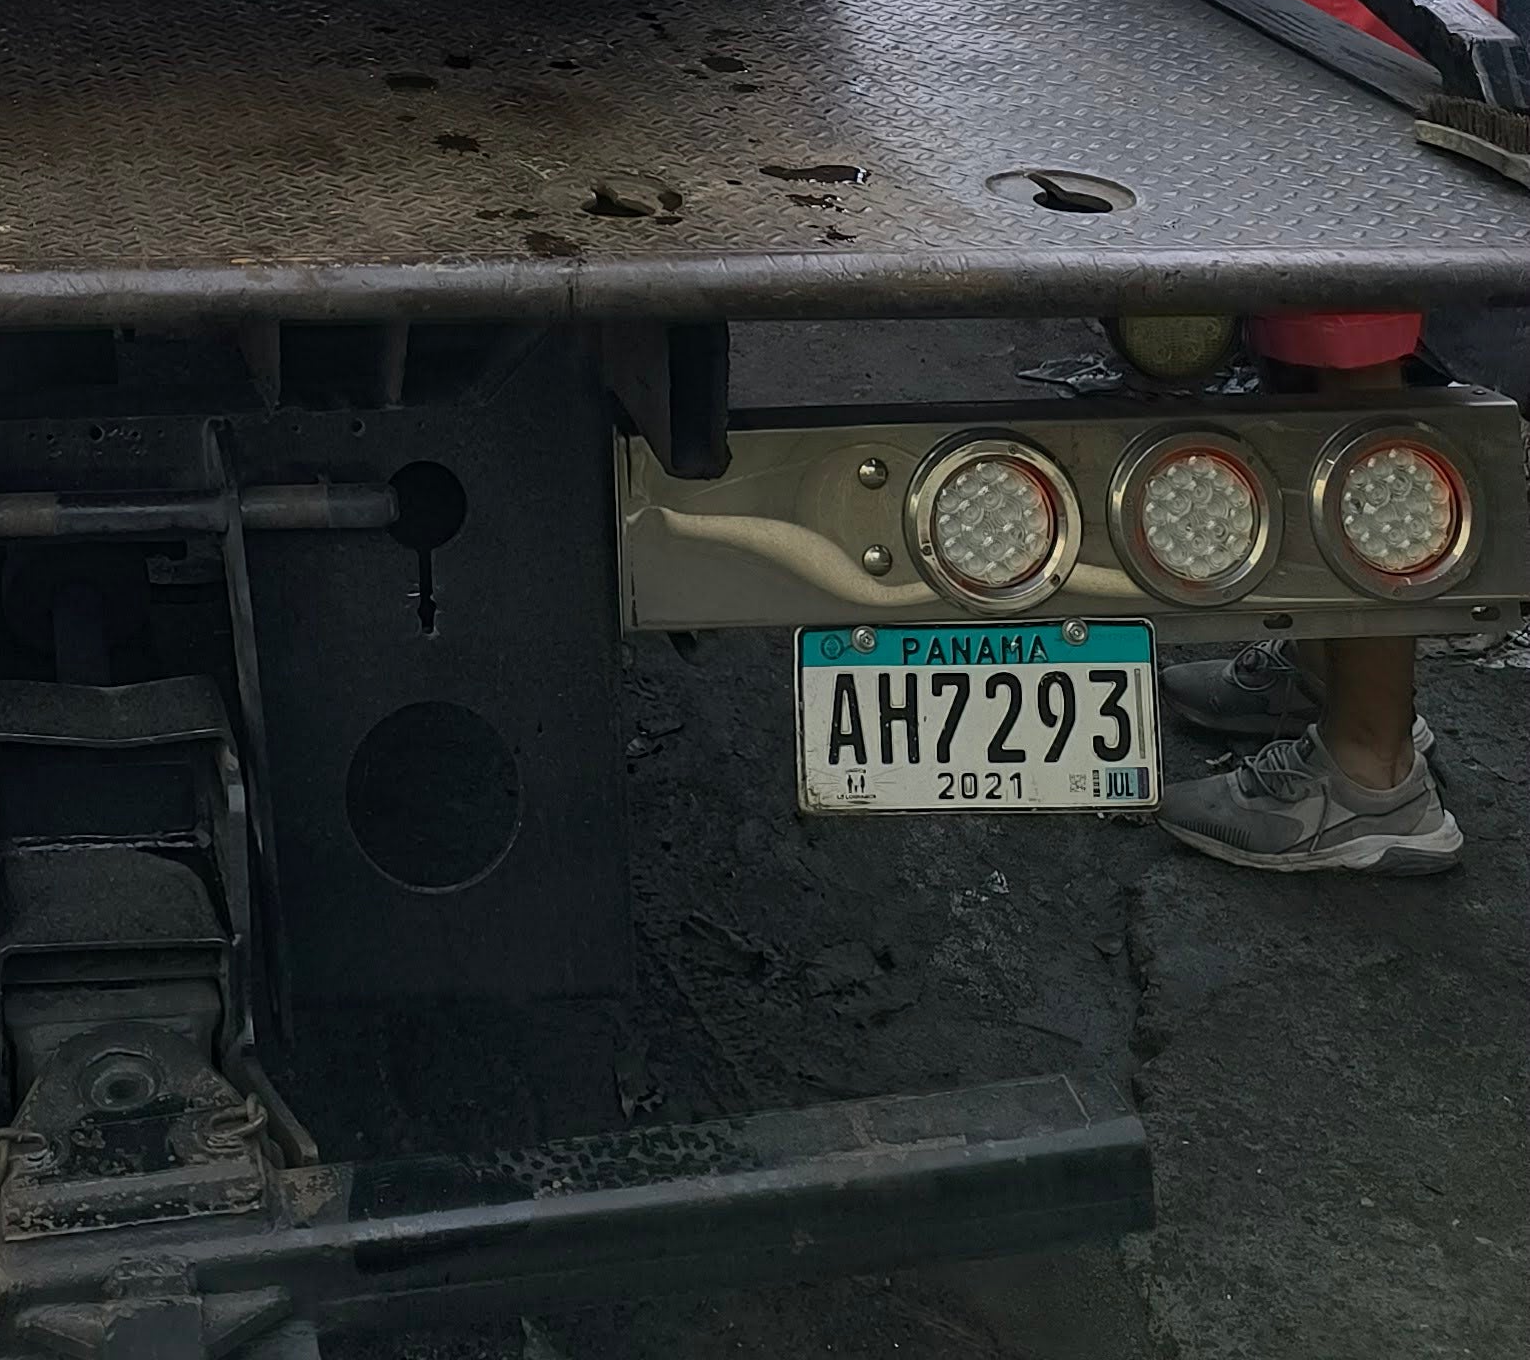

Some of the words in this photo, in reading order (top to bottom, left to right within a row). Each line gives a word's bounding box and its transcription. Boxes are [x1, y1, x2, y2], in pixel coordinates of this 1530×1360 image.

[902, 634, 1050, 665] PANAMA
[828, 669, 1132, 765] AH7293
[936, 771, 1024, 800] 2021
[1106, 772, 1134, 797] JUL
